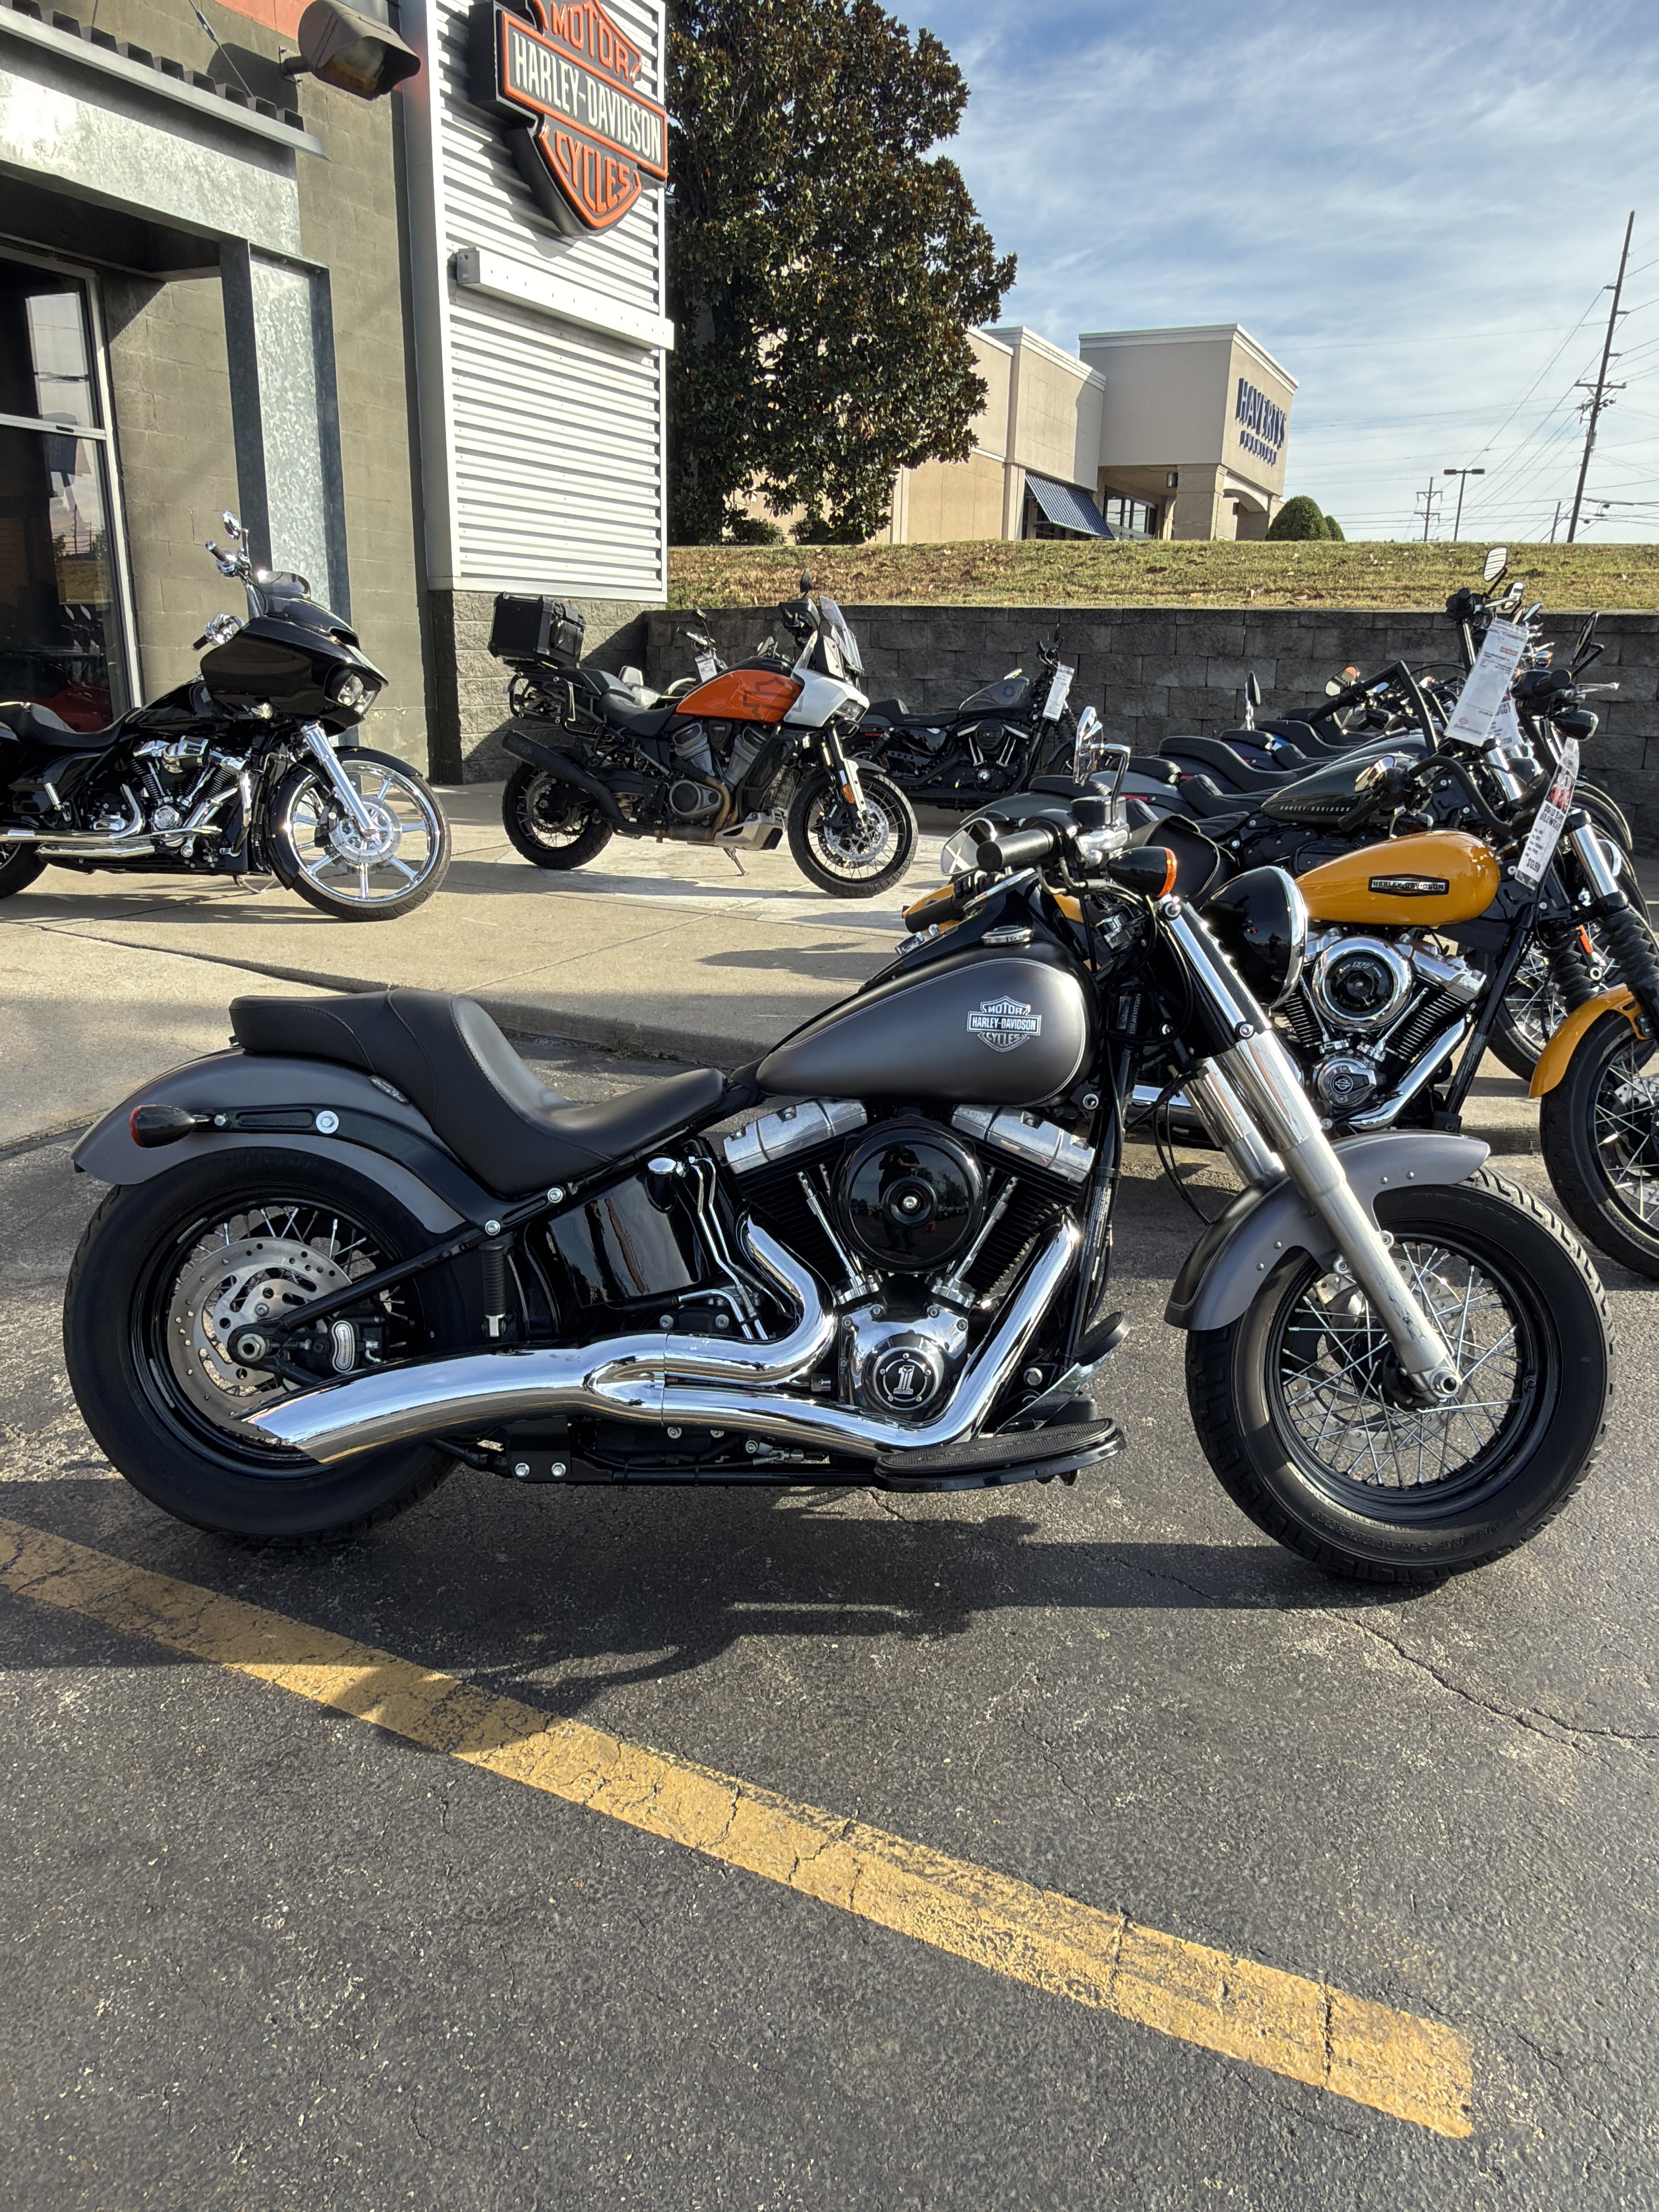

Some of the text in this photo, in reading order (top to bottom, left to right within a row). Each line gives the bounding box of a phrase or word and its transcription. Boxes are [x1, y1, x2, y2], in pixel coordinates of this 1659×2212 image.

[551, 1, 629, 81] MOTOR
[513, 32, 661, 164] HARLEY-DAVIDSON
[554, 131, 631, 214] CYCLES
[1239, 430, 1278, 467] FURNITURE
[1372, 881, 1444, 890] HARLEY-DAVIDSON
[988, 1002, 1022, 1015] MOTOR
[972, 1016, 1036, 1031] HARLEY-DAVIDSON
[986, 1032, 1021, 1047] CYCLES
